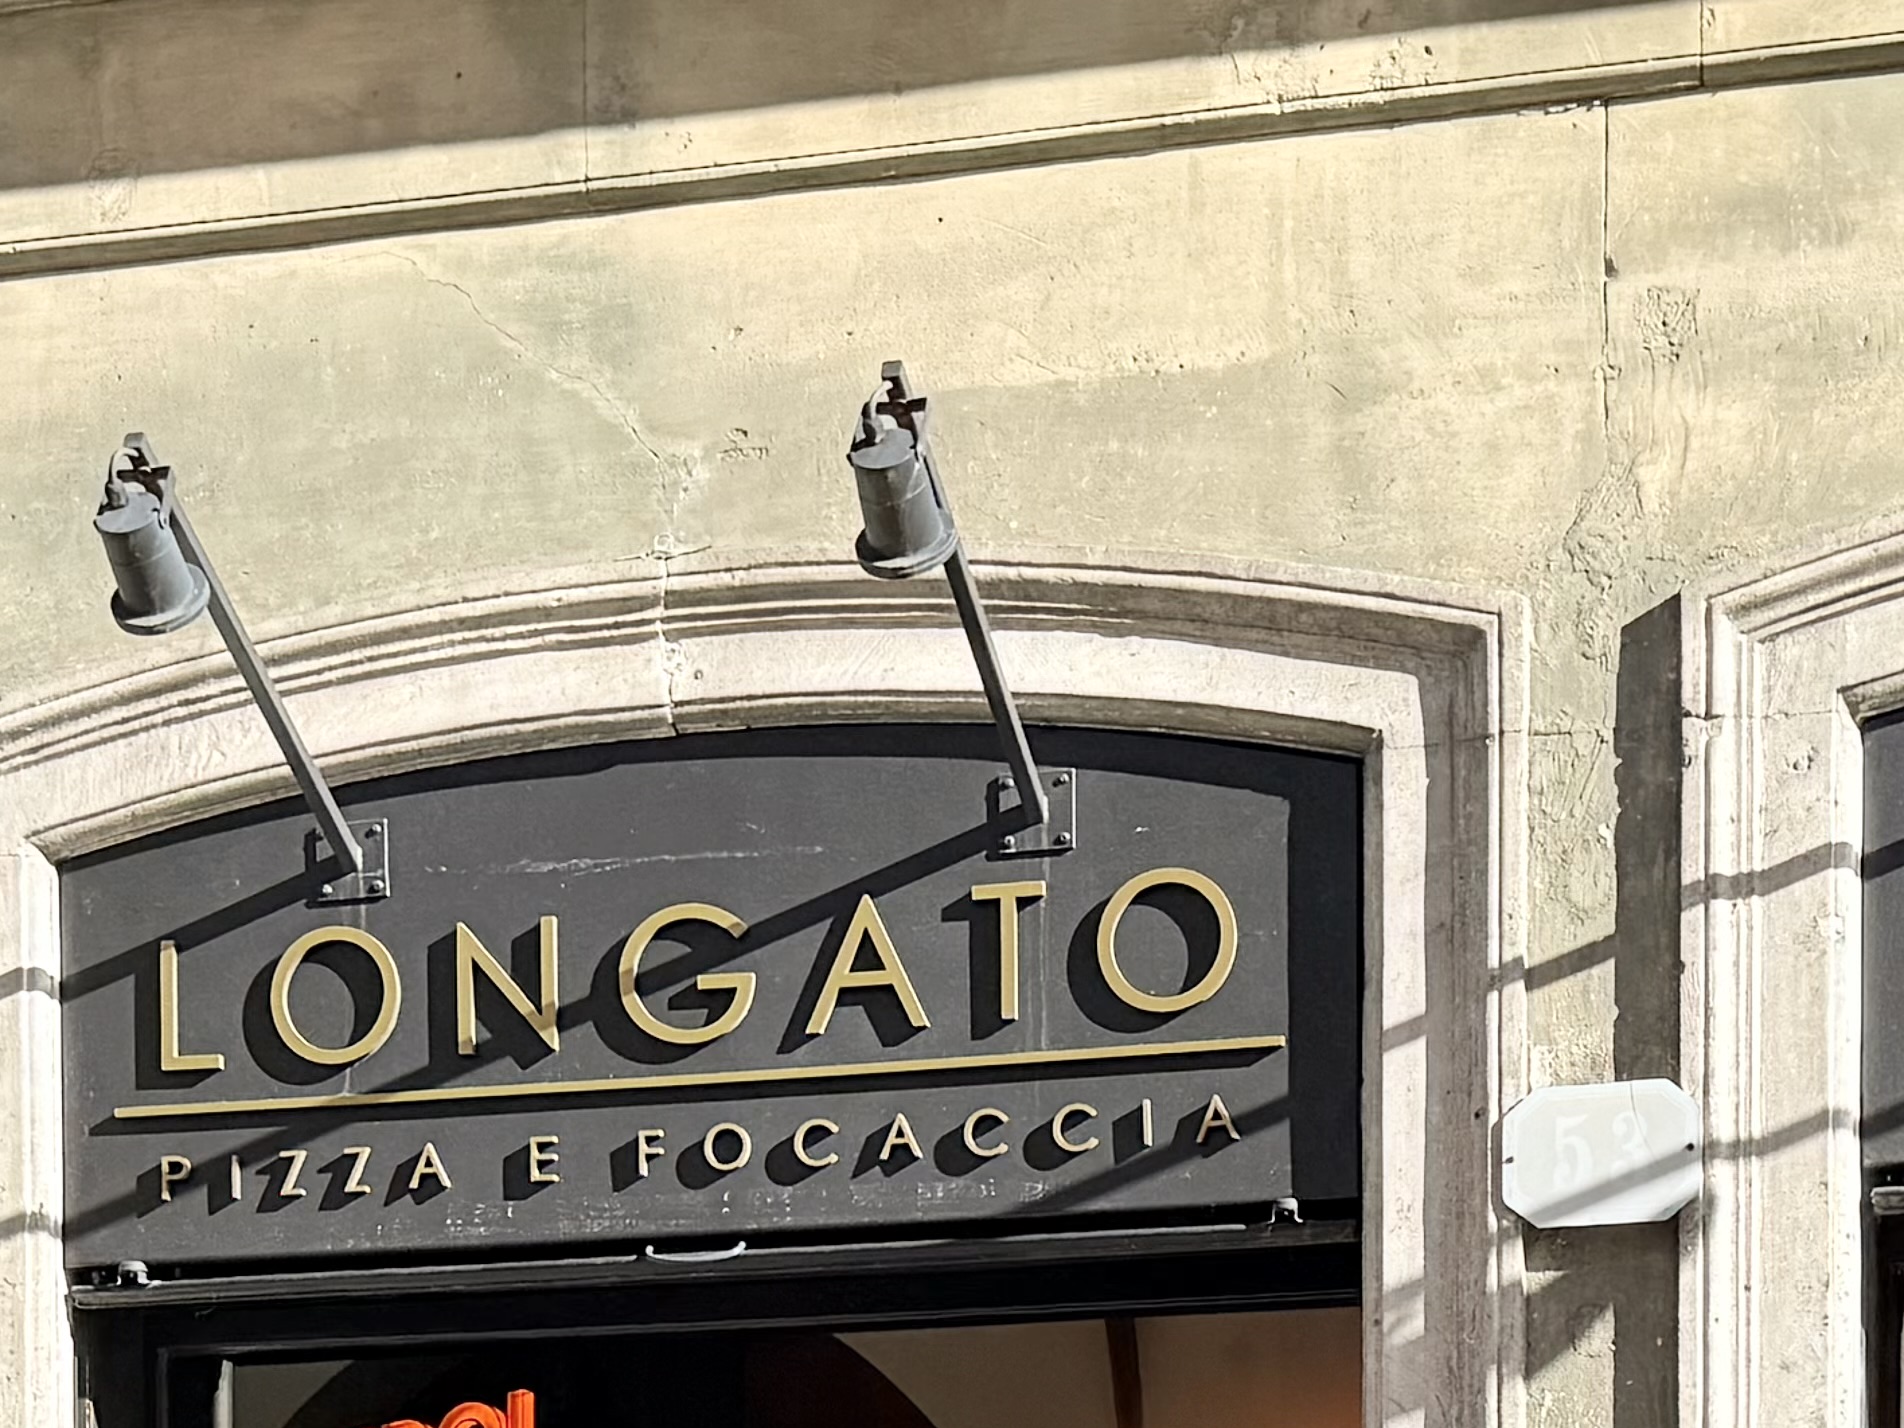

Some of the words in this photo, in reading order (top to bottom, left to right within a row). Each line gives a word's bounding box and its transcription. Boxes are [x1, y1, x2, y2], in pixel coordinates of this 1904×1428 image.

[156, 865, 1238, 1073] LONGATO
[159, 1139, 451, 1202] PIZZA
[528, 1134, 561, 1185] E
[638, 1092, 1242, 1177] FOCACCIA
